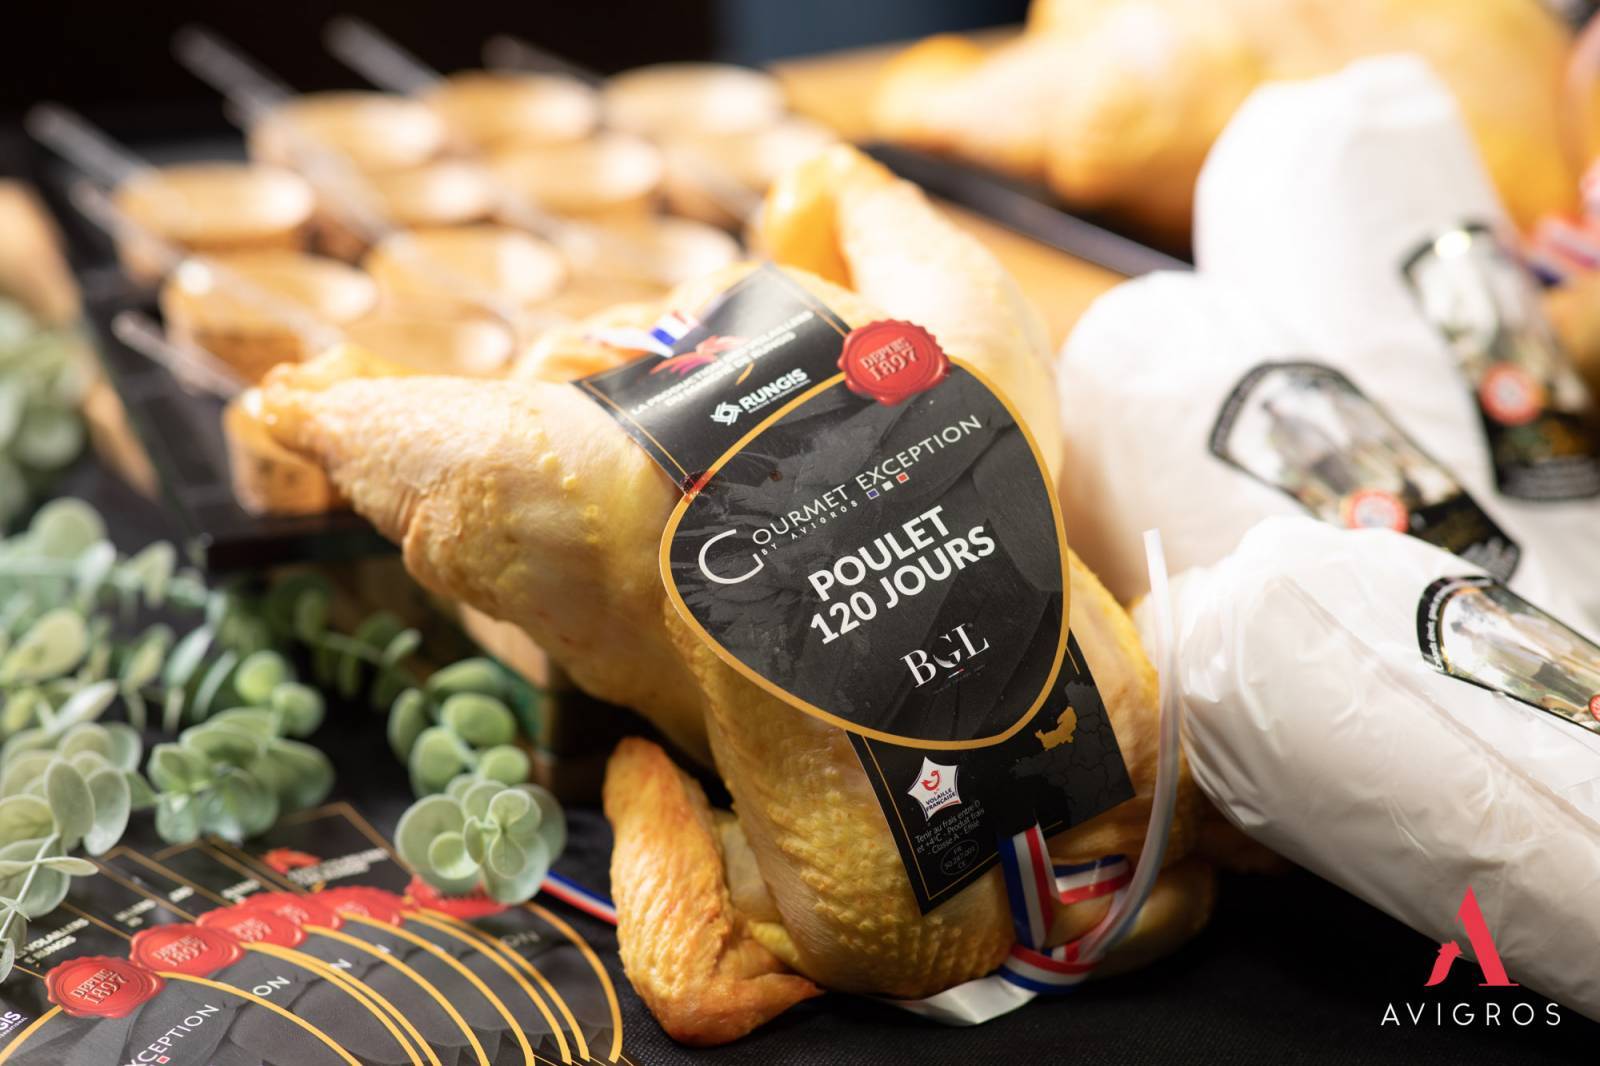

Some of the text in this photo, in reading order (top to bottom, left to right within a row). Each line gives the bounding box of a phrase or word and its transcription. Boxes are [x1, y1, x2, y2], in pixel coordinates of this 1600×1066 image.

[869, 347, 916, 382] 1897
[739, 368, 808, 411] RUNGIS
[698, 415, 982, 584] GOURMET EXCEPTION
[808, 505, 949, 601] POULET
[810, 526, 995, 645] 120 JOURS
[900, 623, 990, 688] BGL
[925, 787, 952, 805] VOLAILLE
[926, 792, 956, 811] FRANÇAISE
[83, 973, 127, 1005] 1897
